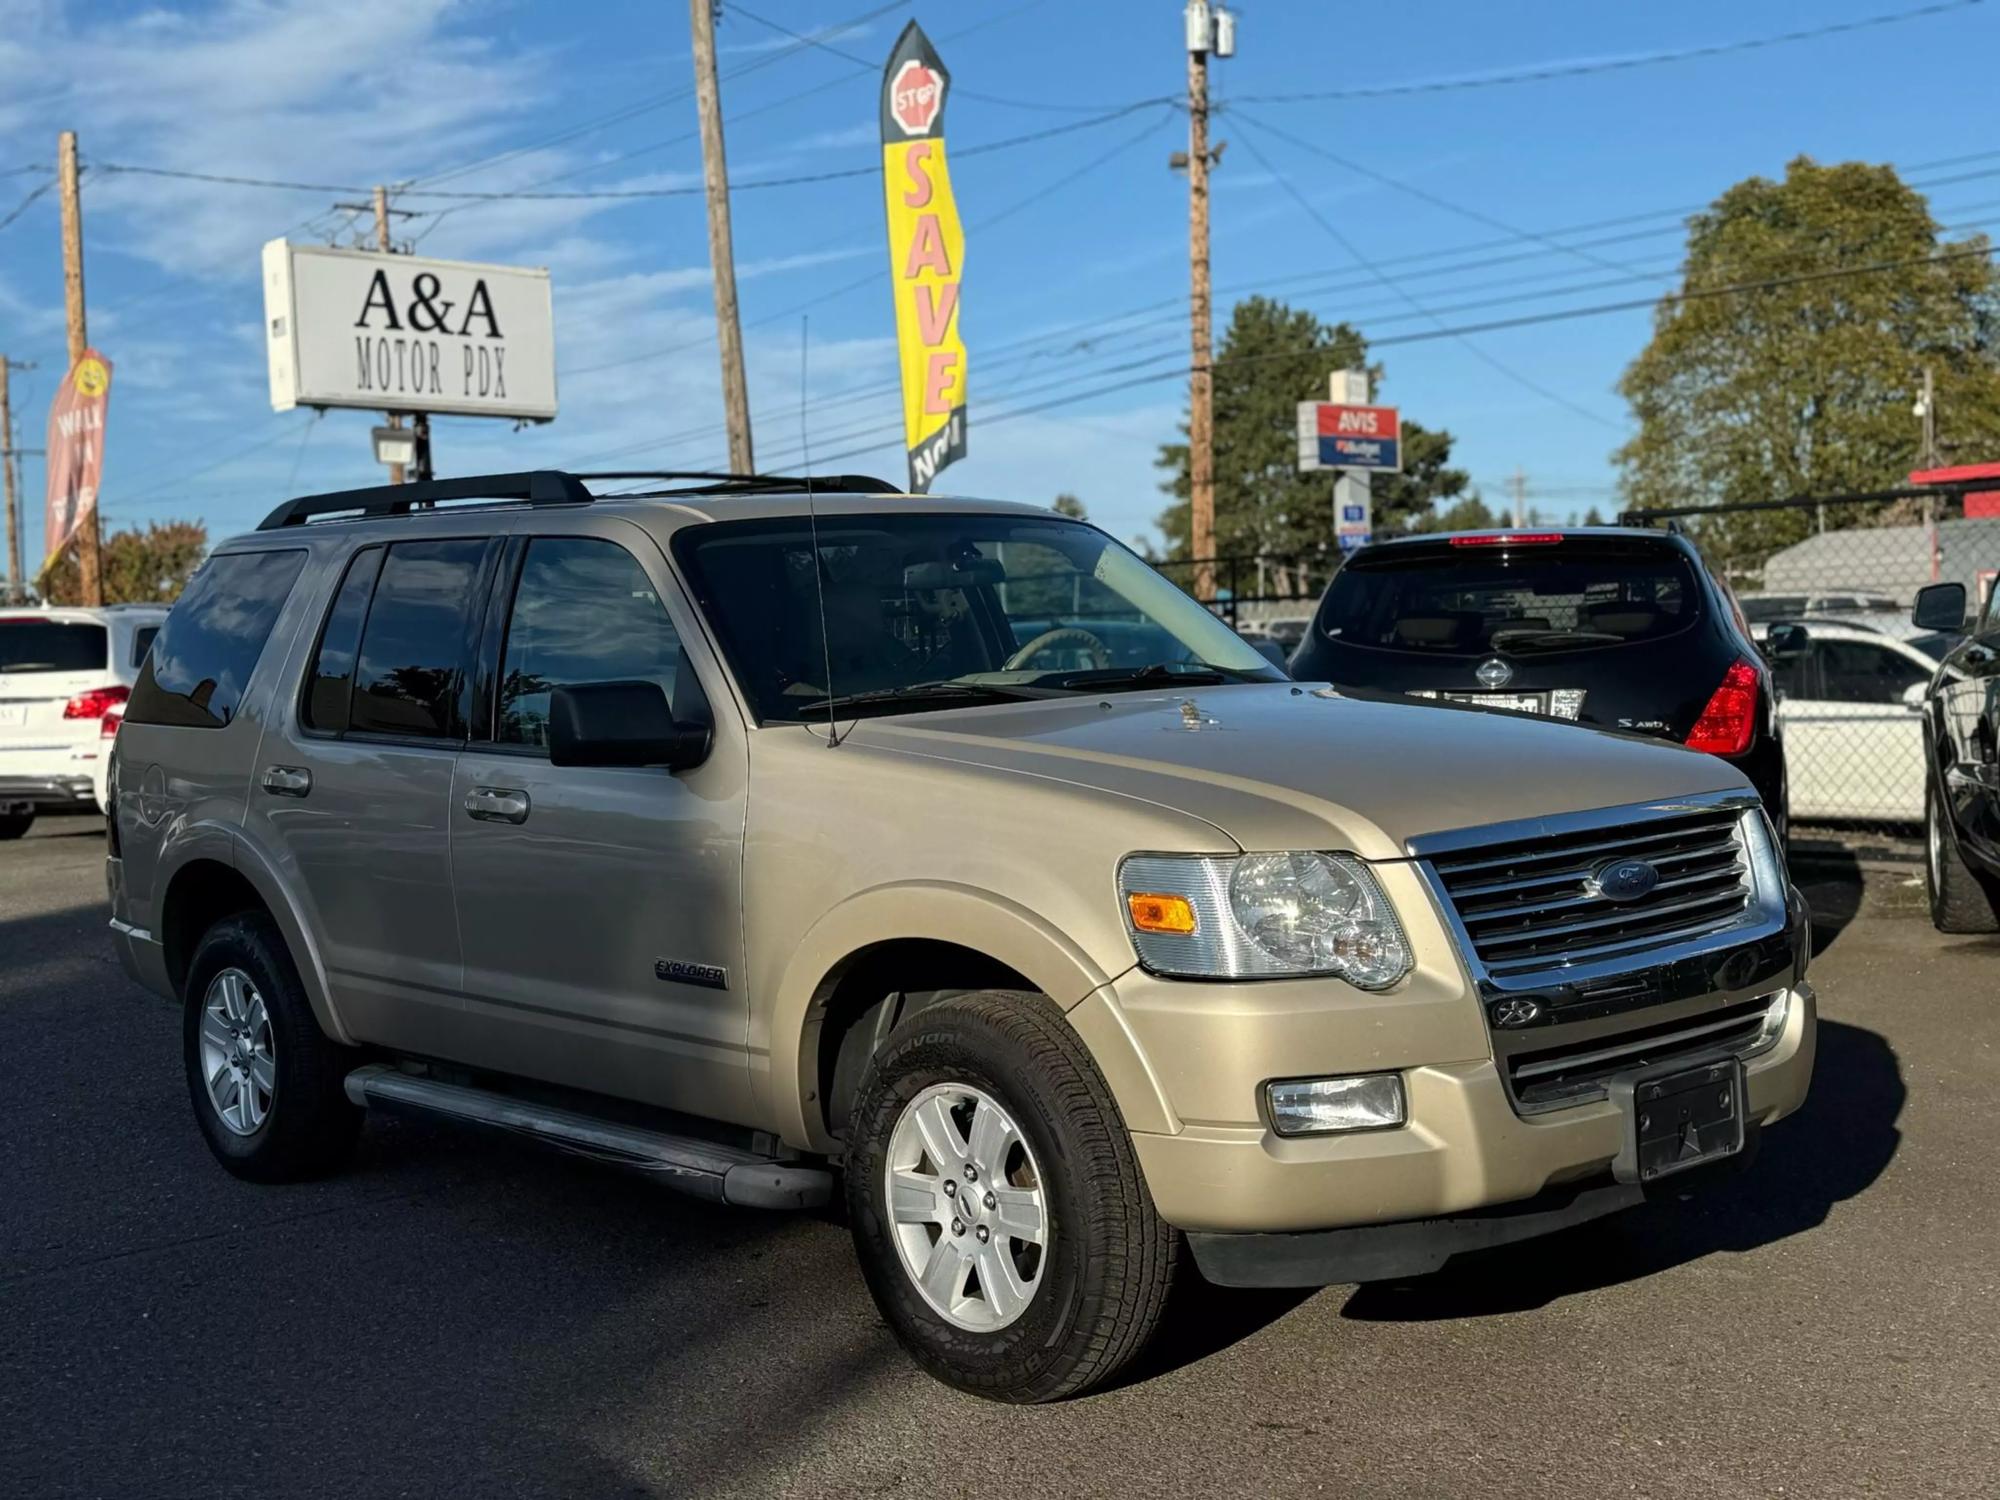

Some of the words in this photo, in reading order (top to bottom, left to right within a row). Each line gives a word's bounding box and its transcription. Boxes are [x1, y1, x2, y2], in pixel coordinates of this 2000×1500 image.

[896, 83, 935, 112] STOP
[904, 143, 959, 415] SAVE
[354, 268, 504, 339] A&A
[356, 336, 442, 395] MOTOR
[463, 344, 506, 398] PDX
[1338, 411, 1378, 434] AVIS
[1618, 718, 1633, 729] S
[1635, 720, 1664, 730] AWD
[657, 960, 723, 980] EXPLORER
